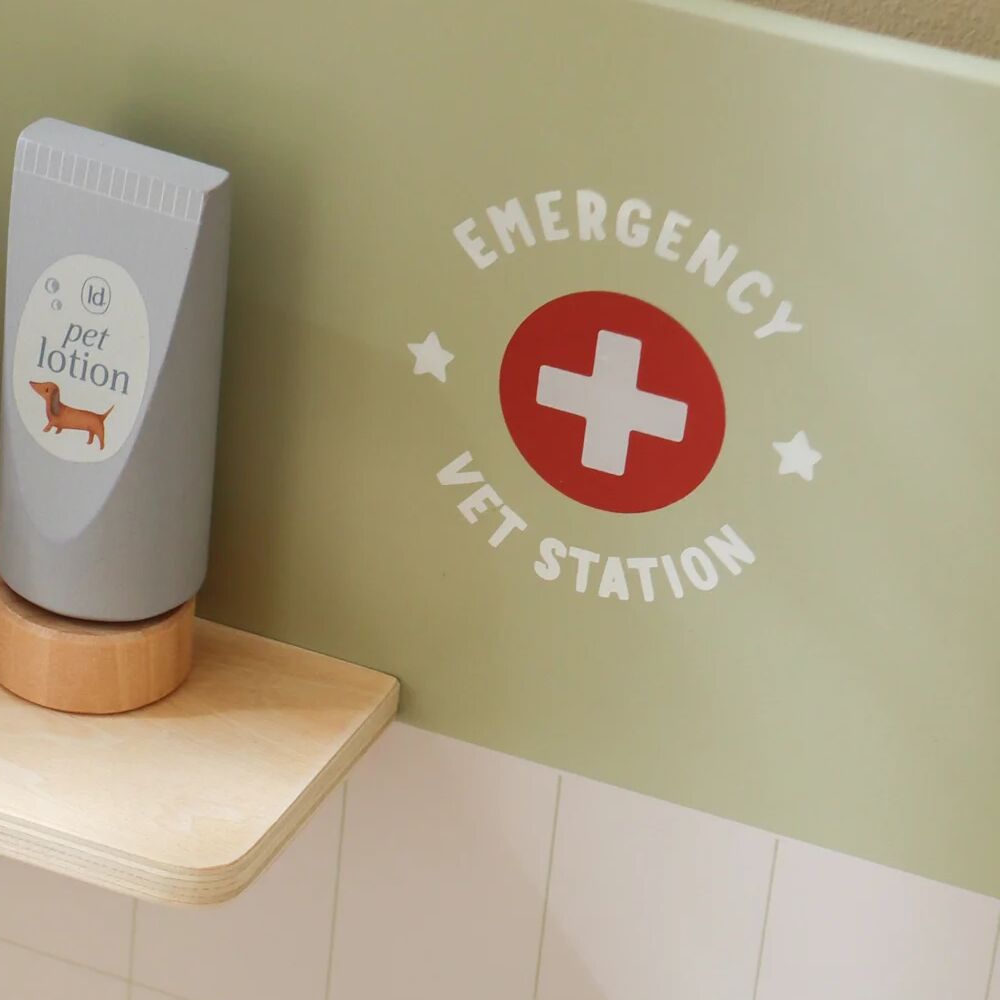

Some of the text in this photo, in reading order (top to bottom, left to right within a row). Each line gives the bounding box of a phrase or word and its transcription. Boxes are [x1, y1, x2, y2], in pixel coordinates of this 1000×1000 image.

[452, 189, 803, 339] EMERGENCY
[36, 336, 131, 395] lotion
[61, 322, 111, 350] pet
[436, 450, 756, 602] VET STATION
